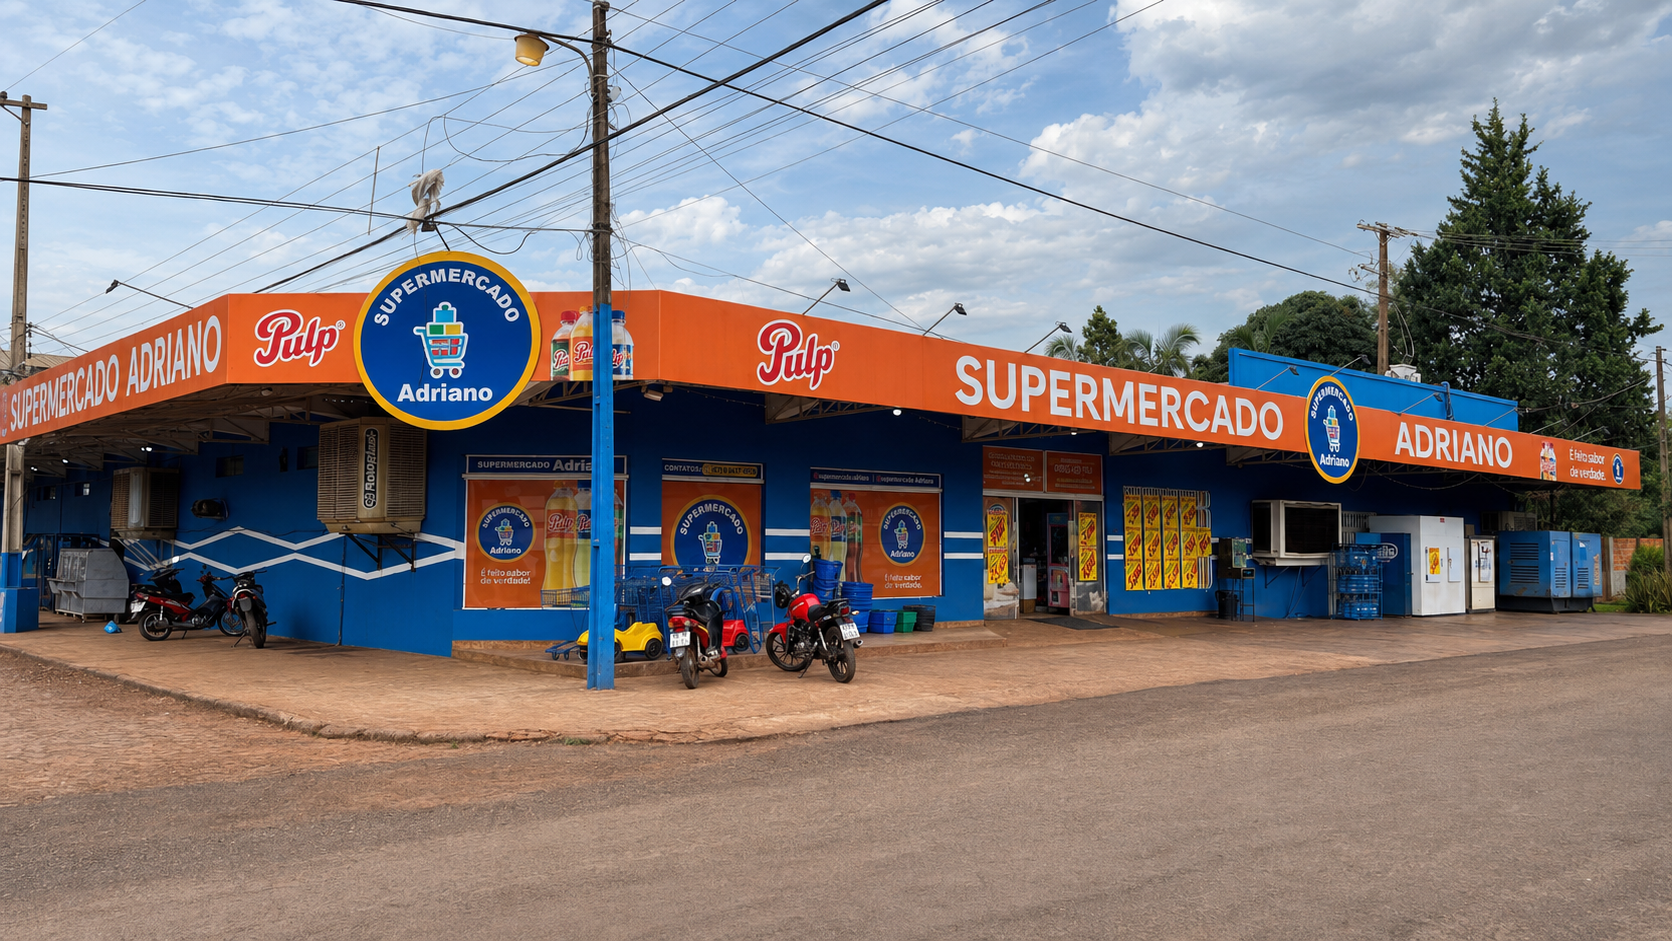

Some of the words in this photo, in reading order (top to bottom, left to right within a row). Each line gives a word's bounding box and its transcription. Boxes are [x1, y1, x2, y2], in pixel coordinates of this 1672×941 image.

[374, 268, 520, 326] SUPERMERCADO
[10, 354, 119, 432] SUPERMERCADO
[126, 314, 222, 397] ADRIANO
[397, 383, 493, 402] Adriano
[1311, 386, 1354, 421] SUPERMERCADO
[955, 355, 1284, 441] SUPERMERCADO
[1395, 421, 1513, 469] ADRIANO
[477, 460, 550, 469] SUPERMERCADO
[552, 459, 592, 472] Adria
[1320, 453, 1350, 468] Adriano
[680, 503, 744, 535] SUPERMERCADO
[506, 568, 531, 577] sabor
